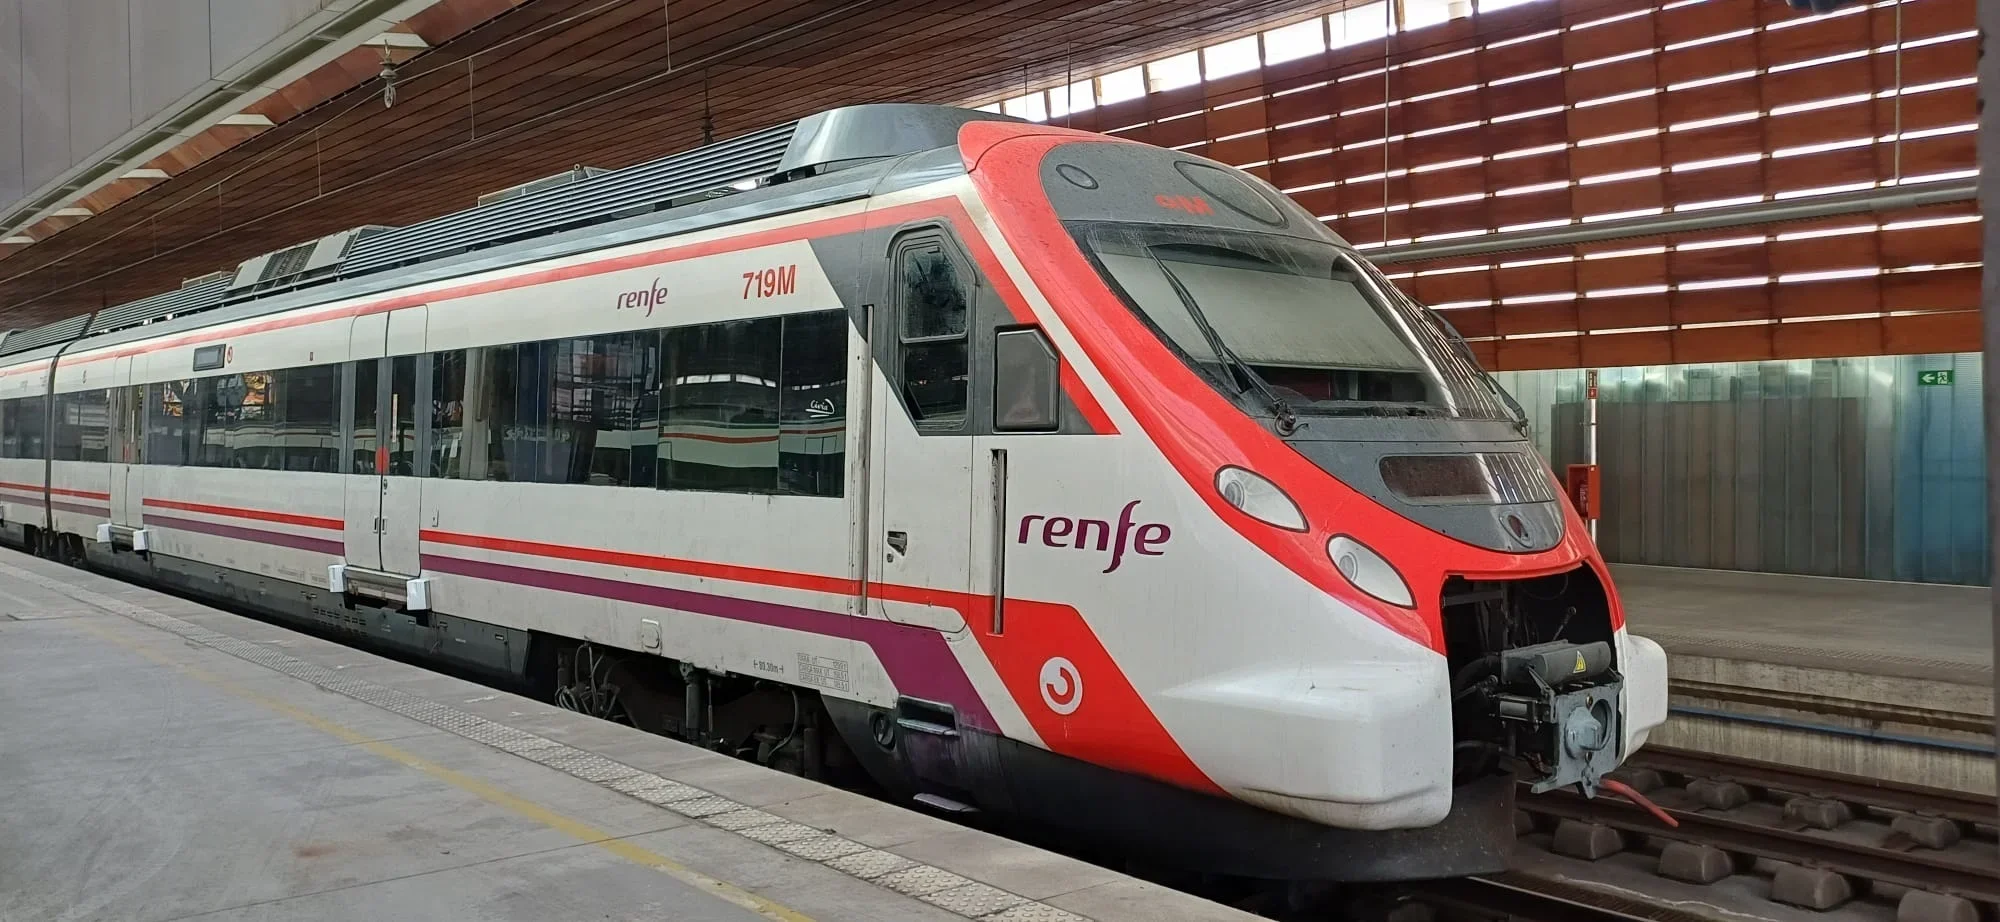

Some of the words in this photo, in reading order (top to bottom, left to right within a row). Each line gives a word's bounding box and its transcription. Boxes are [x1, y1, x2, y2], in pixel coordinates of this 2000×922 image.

[616, 277, 668, 317] renfe
[743, 264, 797, 300] 719M
[1018, 500, 1172, 574] renfe
